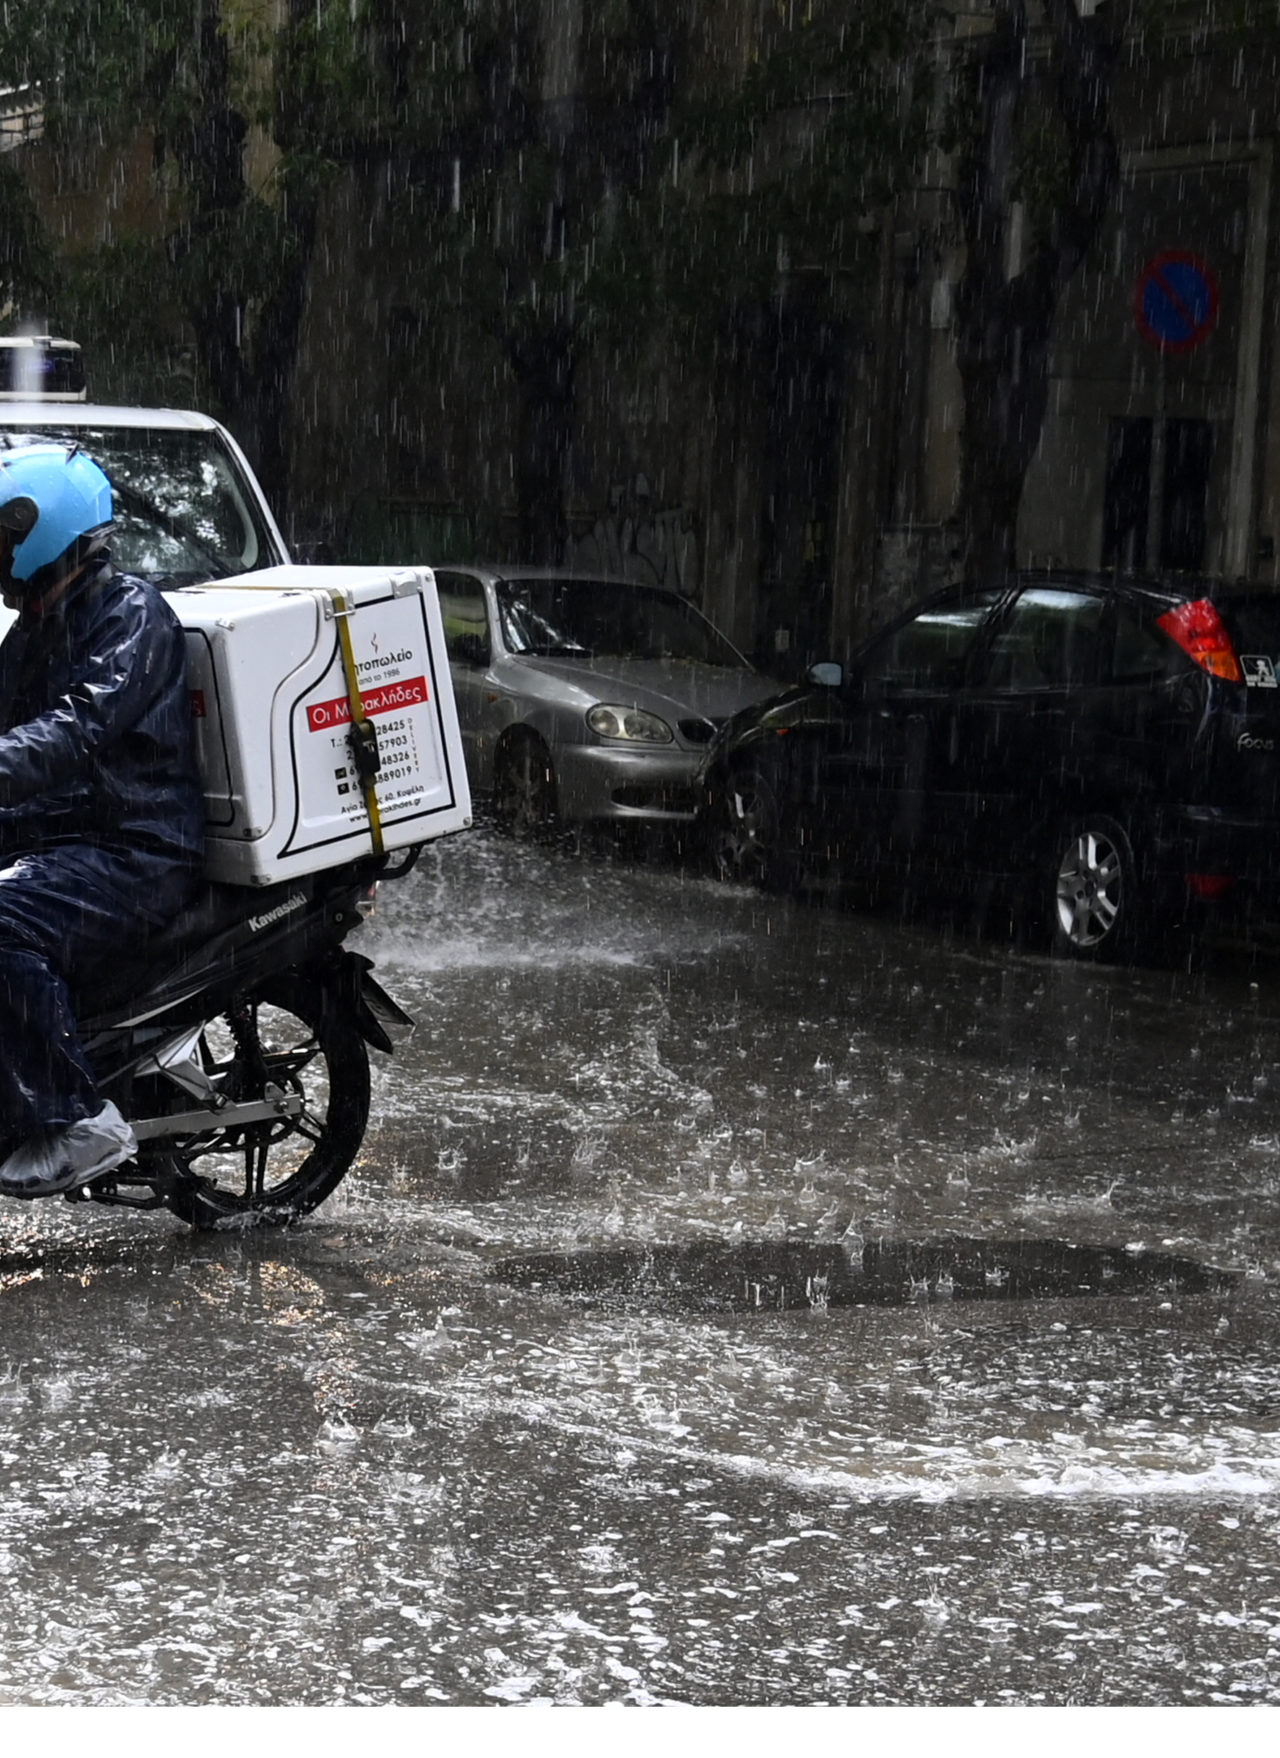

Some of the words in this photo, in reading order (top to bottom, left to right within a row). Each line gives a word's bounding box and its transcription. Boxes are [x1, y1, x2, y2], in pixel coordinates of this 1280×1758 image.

[342, 649, 413, 676] ητοπωλείο
[335, 686, 422, 719] Μακλήδες
[248, 891, 308, 932] Kawasaki
